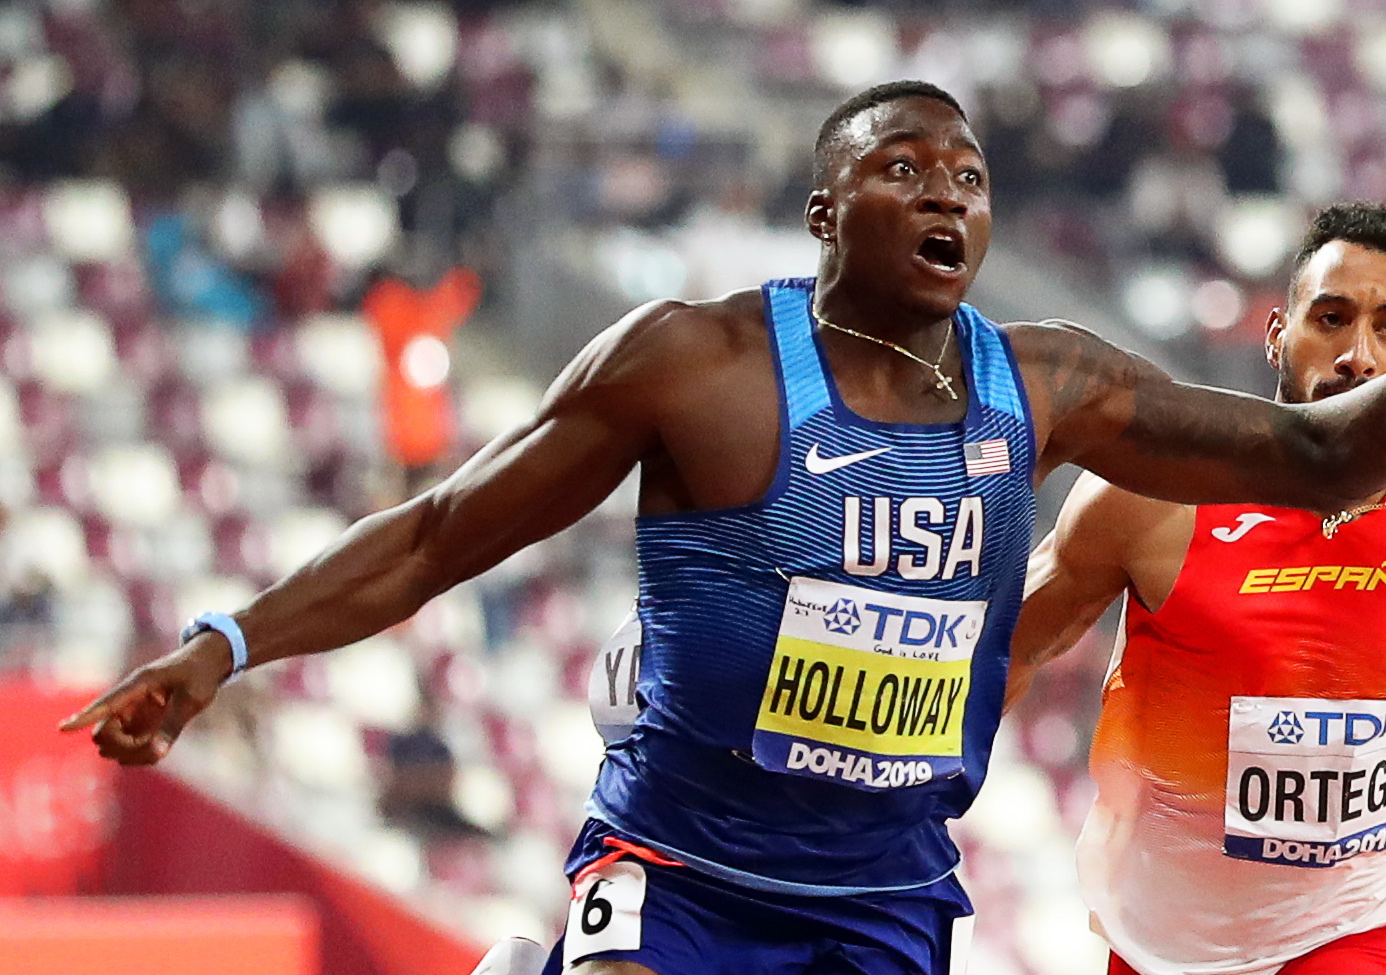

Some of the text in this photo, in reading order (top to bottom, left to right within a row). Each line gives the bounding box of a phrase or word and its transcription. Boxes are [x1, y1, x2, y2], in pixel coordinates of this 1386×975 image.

[843, 496, 984, 580] USA
[864, 603, 966, 648] TDK
[769, 655, 964, 736] HOLLOWAY
[786, 742, 933, 788] DOHA2019
[581, 878, 614, 936] 6
